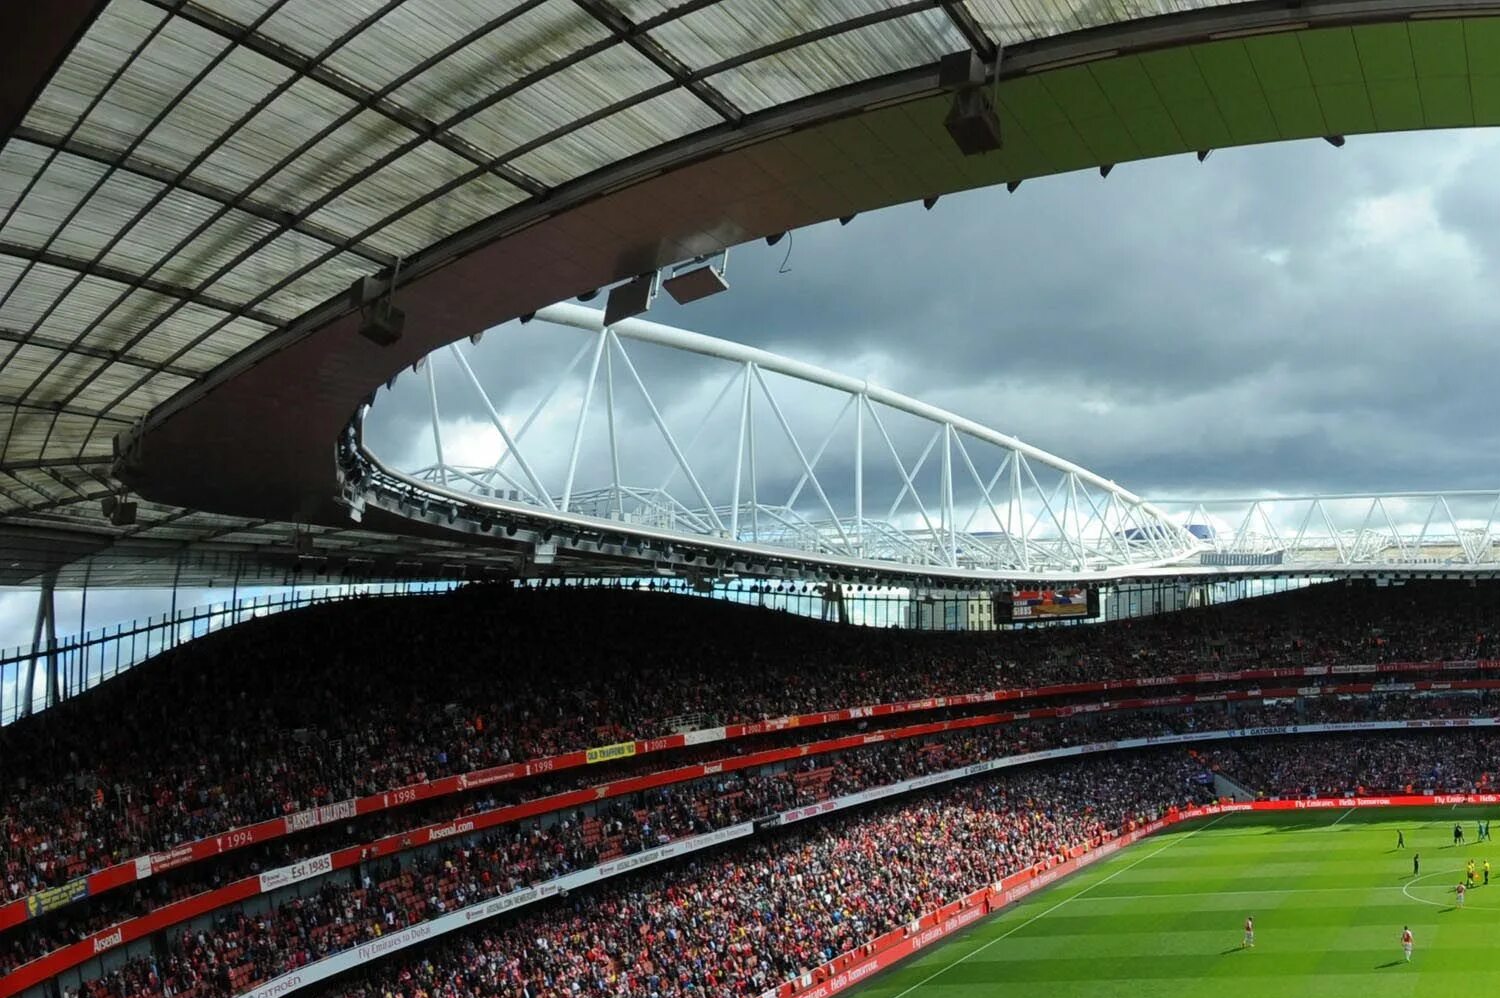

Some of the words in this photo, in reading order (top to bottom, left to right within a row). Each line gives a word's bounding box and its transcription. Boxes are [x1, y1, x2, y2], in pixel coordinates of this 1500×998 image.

[393, 789, 416, 804] 1998
[228, 830, 253, 849] 1994
[428, 821, 475, 841] Arsenal.com
[291, 864, 308, 880] Est.
[308, 857, 330, 876] 1985
[93, 928, 122, 953] Arsenal
[358, 946, 370, 960] Fly
[371, 936, 401, 956] Emirates
[411, 925, 431, 940] Dubai
[830, 974, 847, 992] Hello
